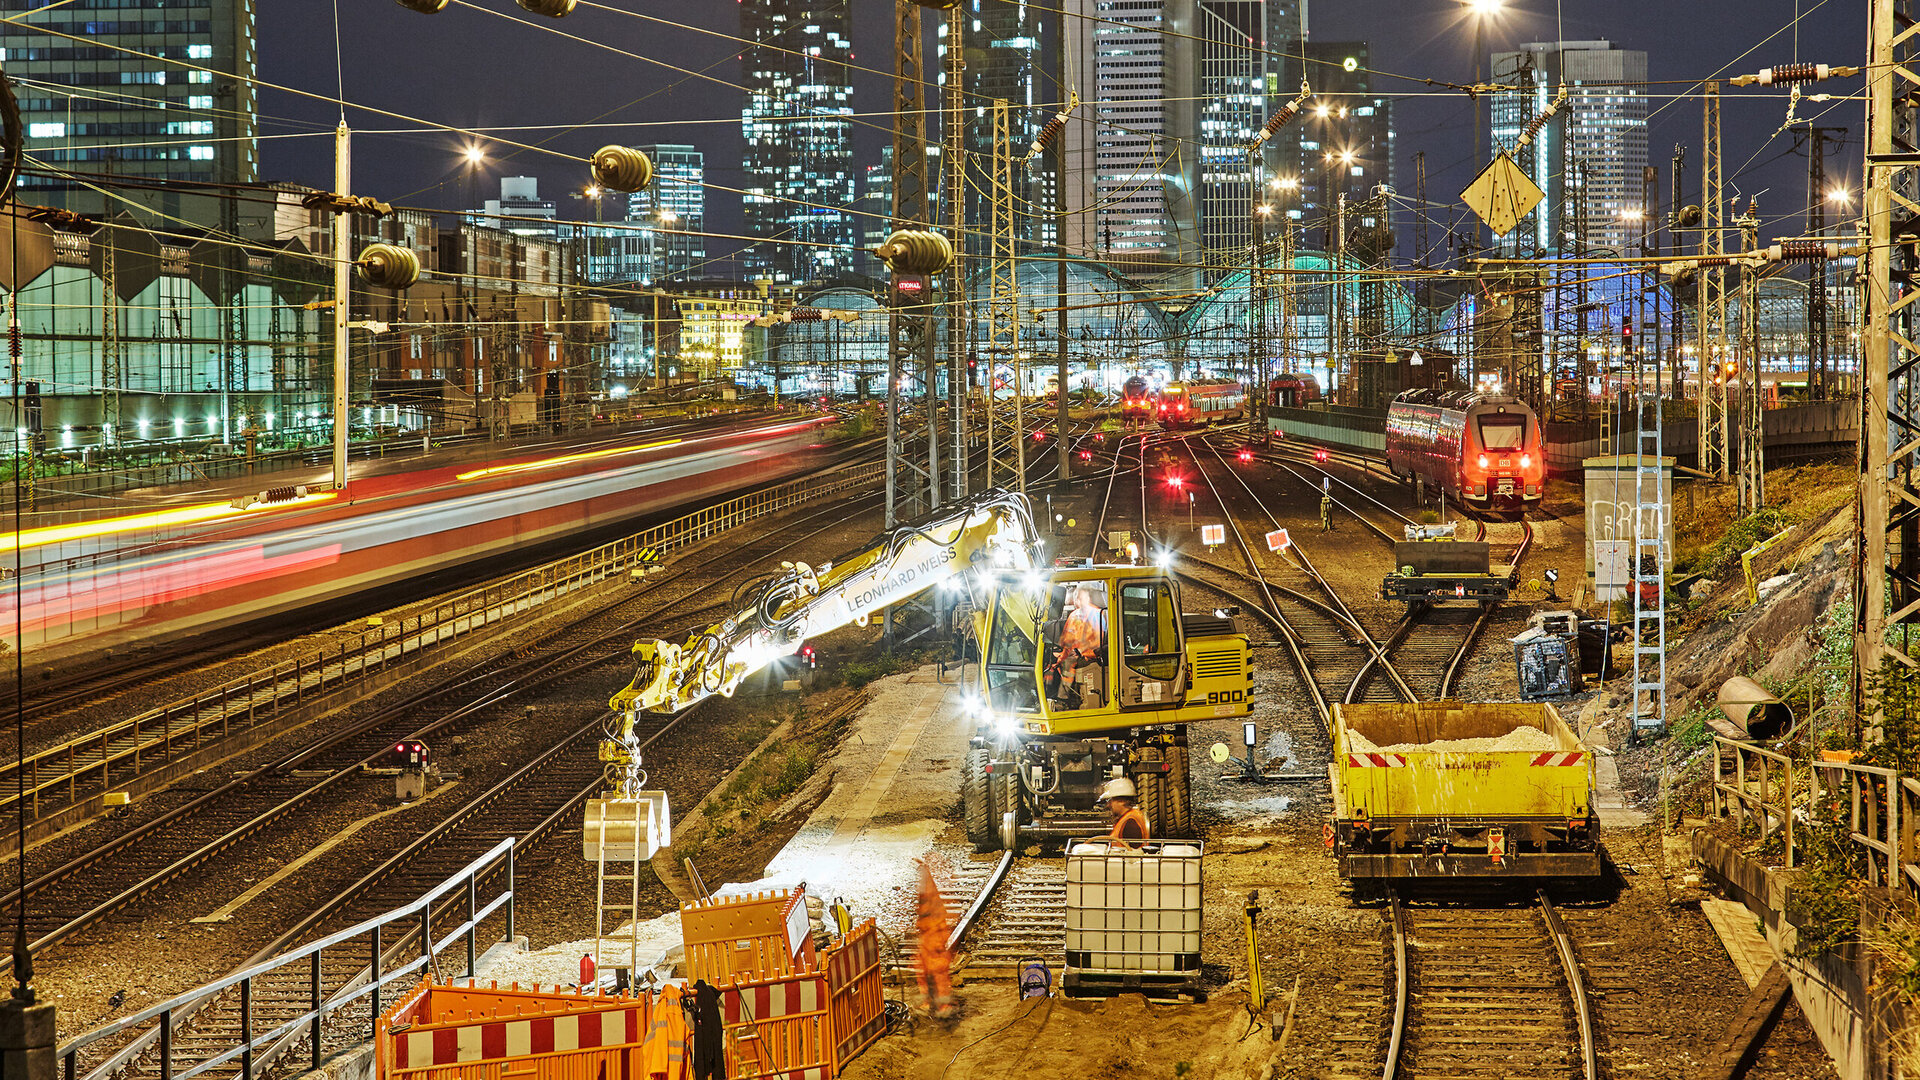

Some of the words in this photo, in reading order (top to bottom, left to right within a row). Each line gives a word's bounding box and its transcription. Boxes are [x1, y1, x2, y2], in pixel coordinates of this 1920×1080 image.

[847, 568, 916, 612] LEONHARD
[917, 546, 957, 574] WEISS
[1208, 690, 1242, 704] 900
